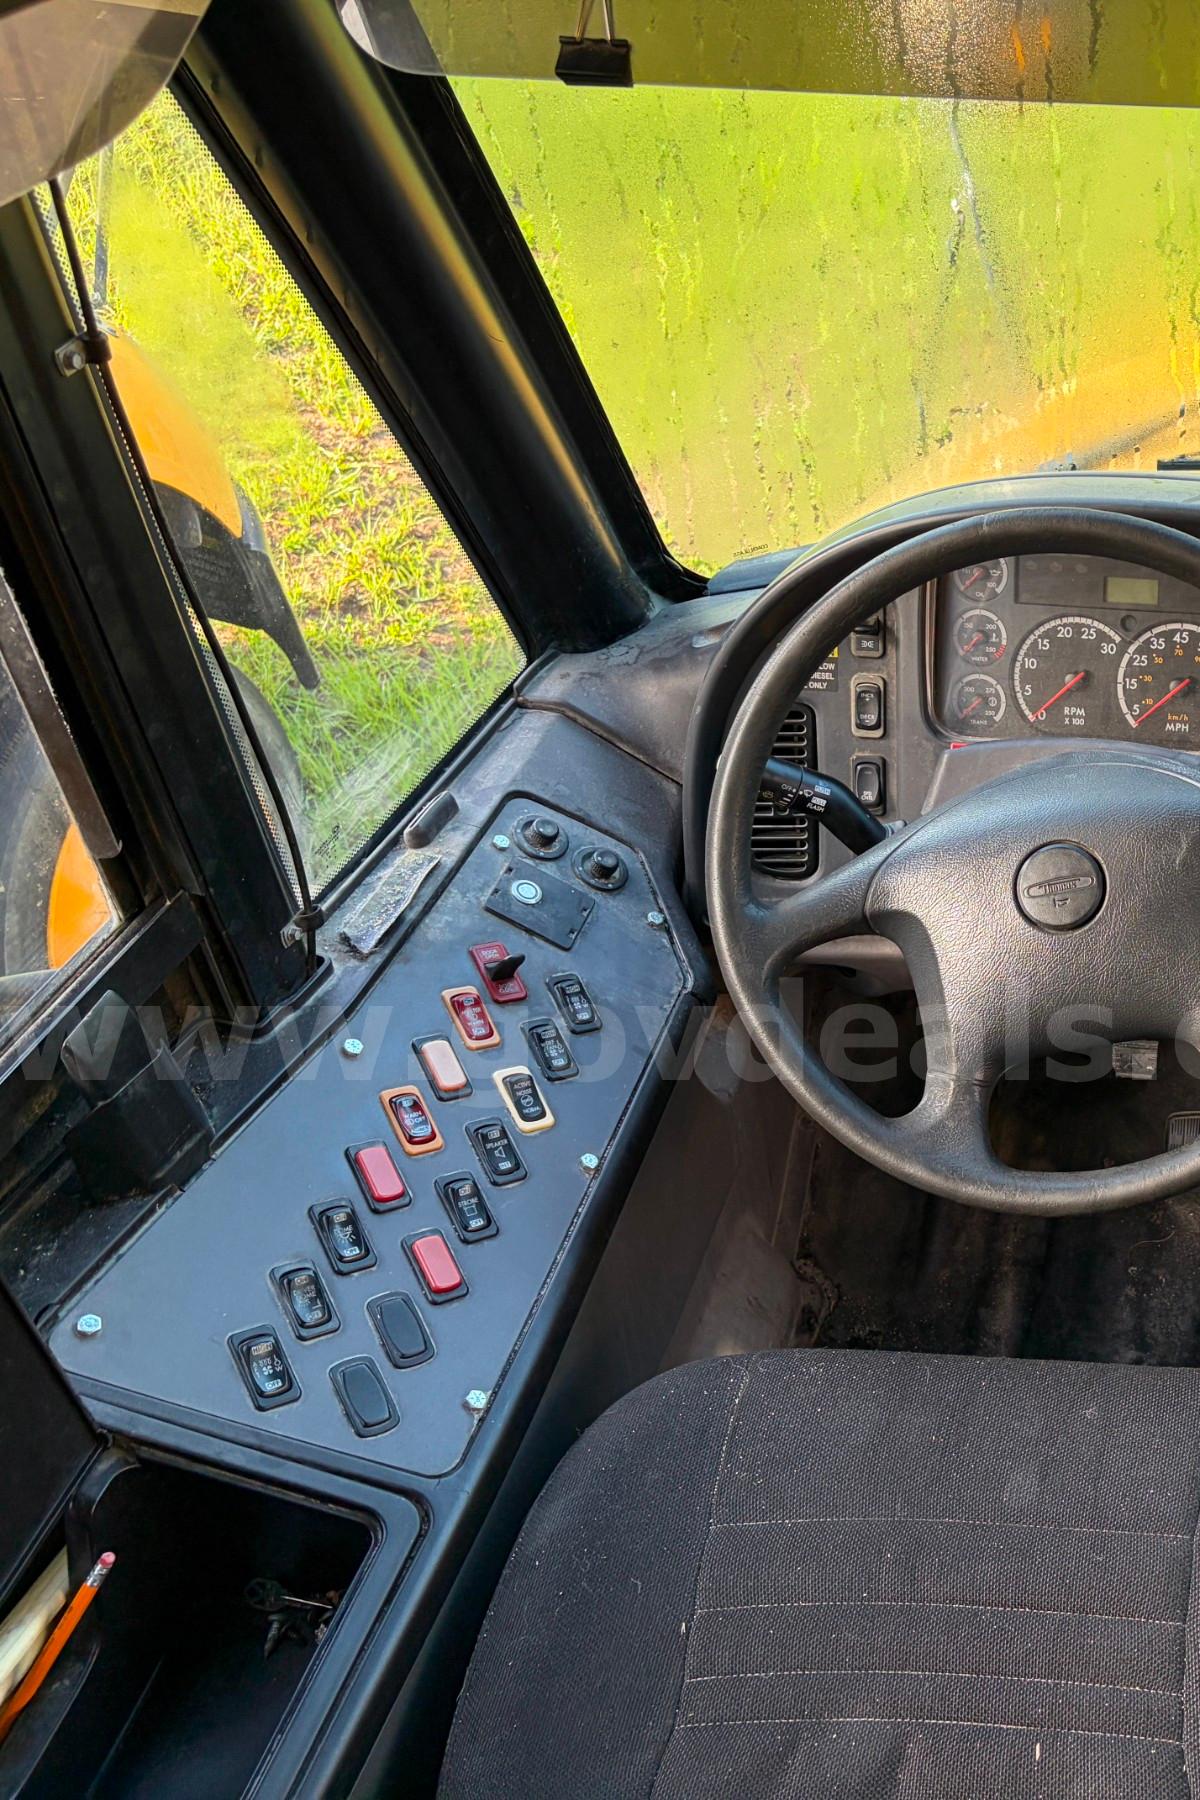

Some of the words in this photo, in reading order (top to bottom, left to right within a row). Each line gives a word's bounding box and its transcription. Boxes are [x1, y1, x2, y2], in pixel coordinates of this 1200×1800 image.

[1056, 626, 1073, 639] 20
[1080, 628, 1097, 640] 25
[1173, 631, 1190, 644] 45
[1037, 638, 1050, 650] 15
[1100, 643, 1117, 655] 30
[1150, 637, 1166, 650] 35
[1023, 658, 1037, 669] 10
[1132, 654, 1148, 667] 25
[808, 681, 828, 689] ONLY
[1125, 678, 1138, 690] 15
[1023, 684, 1032, 696] 5
[1038, 709, 1047, 720] 0
[1064, 706, 1086, 717] RPM
[1132, 704, 1140, 715] 5
[1064, 717, 1070, 725] X
[1072, 717, 1085, 726] 100
[1167, 713, 1189, 721] km/h
[1165, 724, 1190, 732] MPH
[513, 1080, 532, 1089] ACTIVE
[516, 1088, 533, 1096] NOISE
[485, 1139, 508, 1149] SPEAKER
[458, 1197, 479, 1208] STROBE
[265, 1379, 282, 1390] OFF
